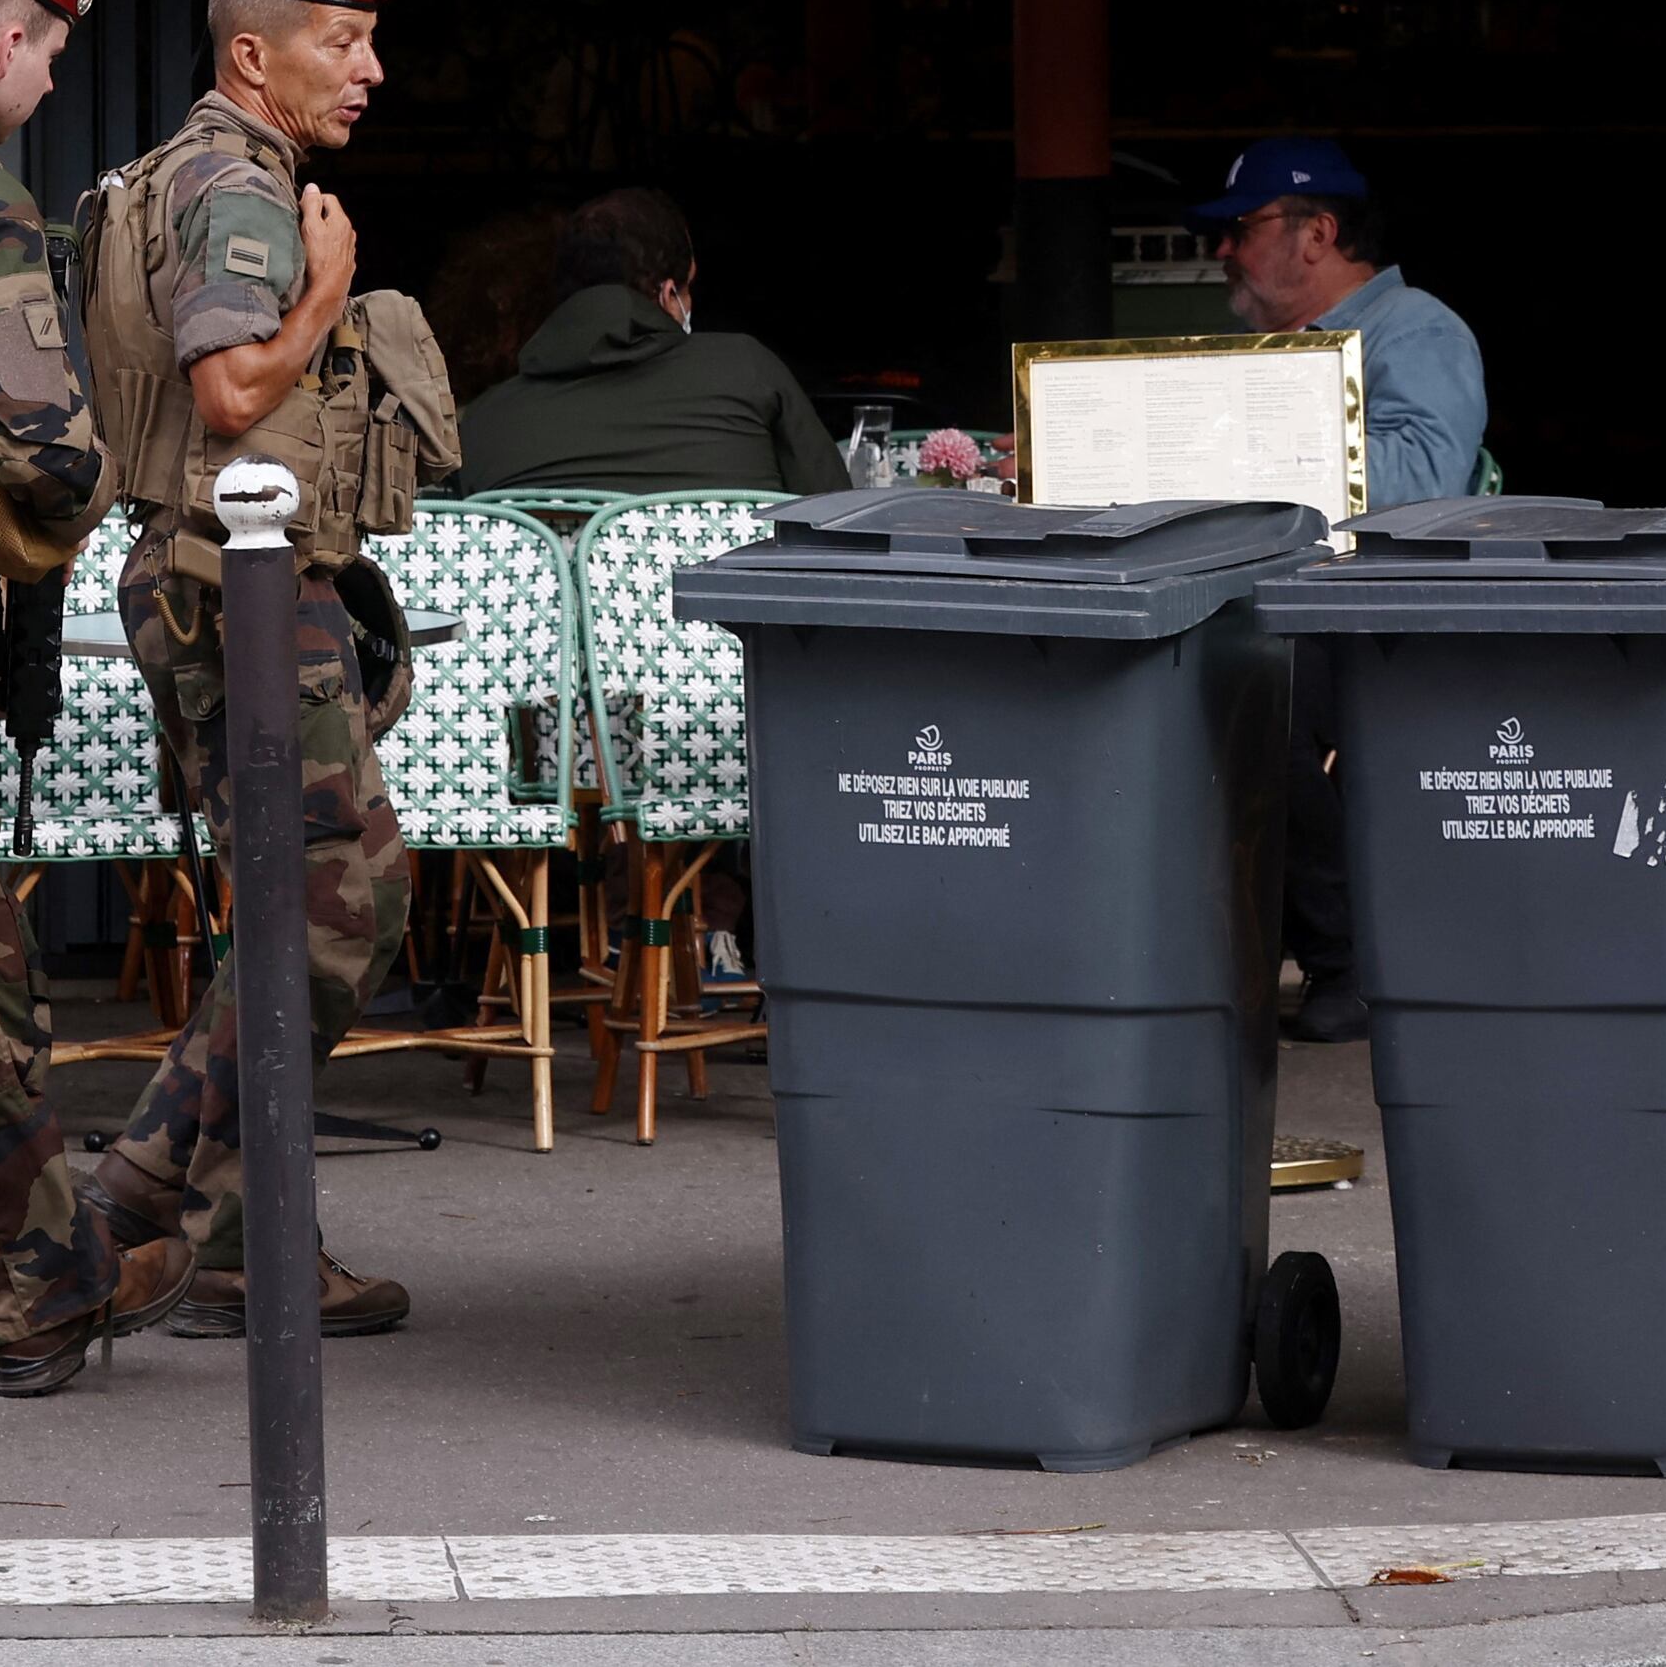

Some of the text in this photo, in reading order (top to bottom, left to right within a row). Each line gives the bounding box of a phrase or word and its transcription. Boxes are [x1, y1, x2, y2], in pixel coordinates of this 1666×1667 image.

[908, 751, 952, 765] PARIS
[1489, 745, 1534, 758] PARIS
[839, 770, 1029, 798] NE DÉPOSEZ RIEN SUR LA VOIE PUBLIQUE
[1420, 767, 1612, 790] NE DÉPOSEZ RIEN SUR LA VOIE PUBLIQUE
[883, 798, 986, 822] TRIEZ VOS DÉCHETS
[1466, 791, 1570, 814] TRIEZ VOS DÉCHETS
[859, 823, 1009, 847] UTILISEZ LE BAC APPROPRIÉ
[1442, 814, 1594, 839] UTILISEZ LE BAC APPROPRIÉ
